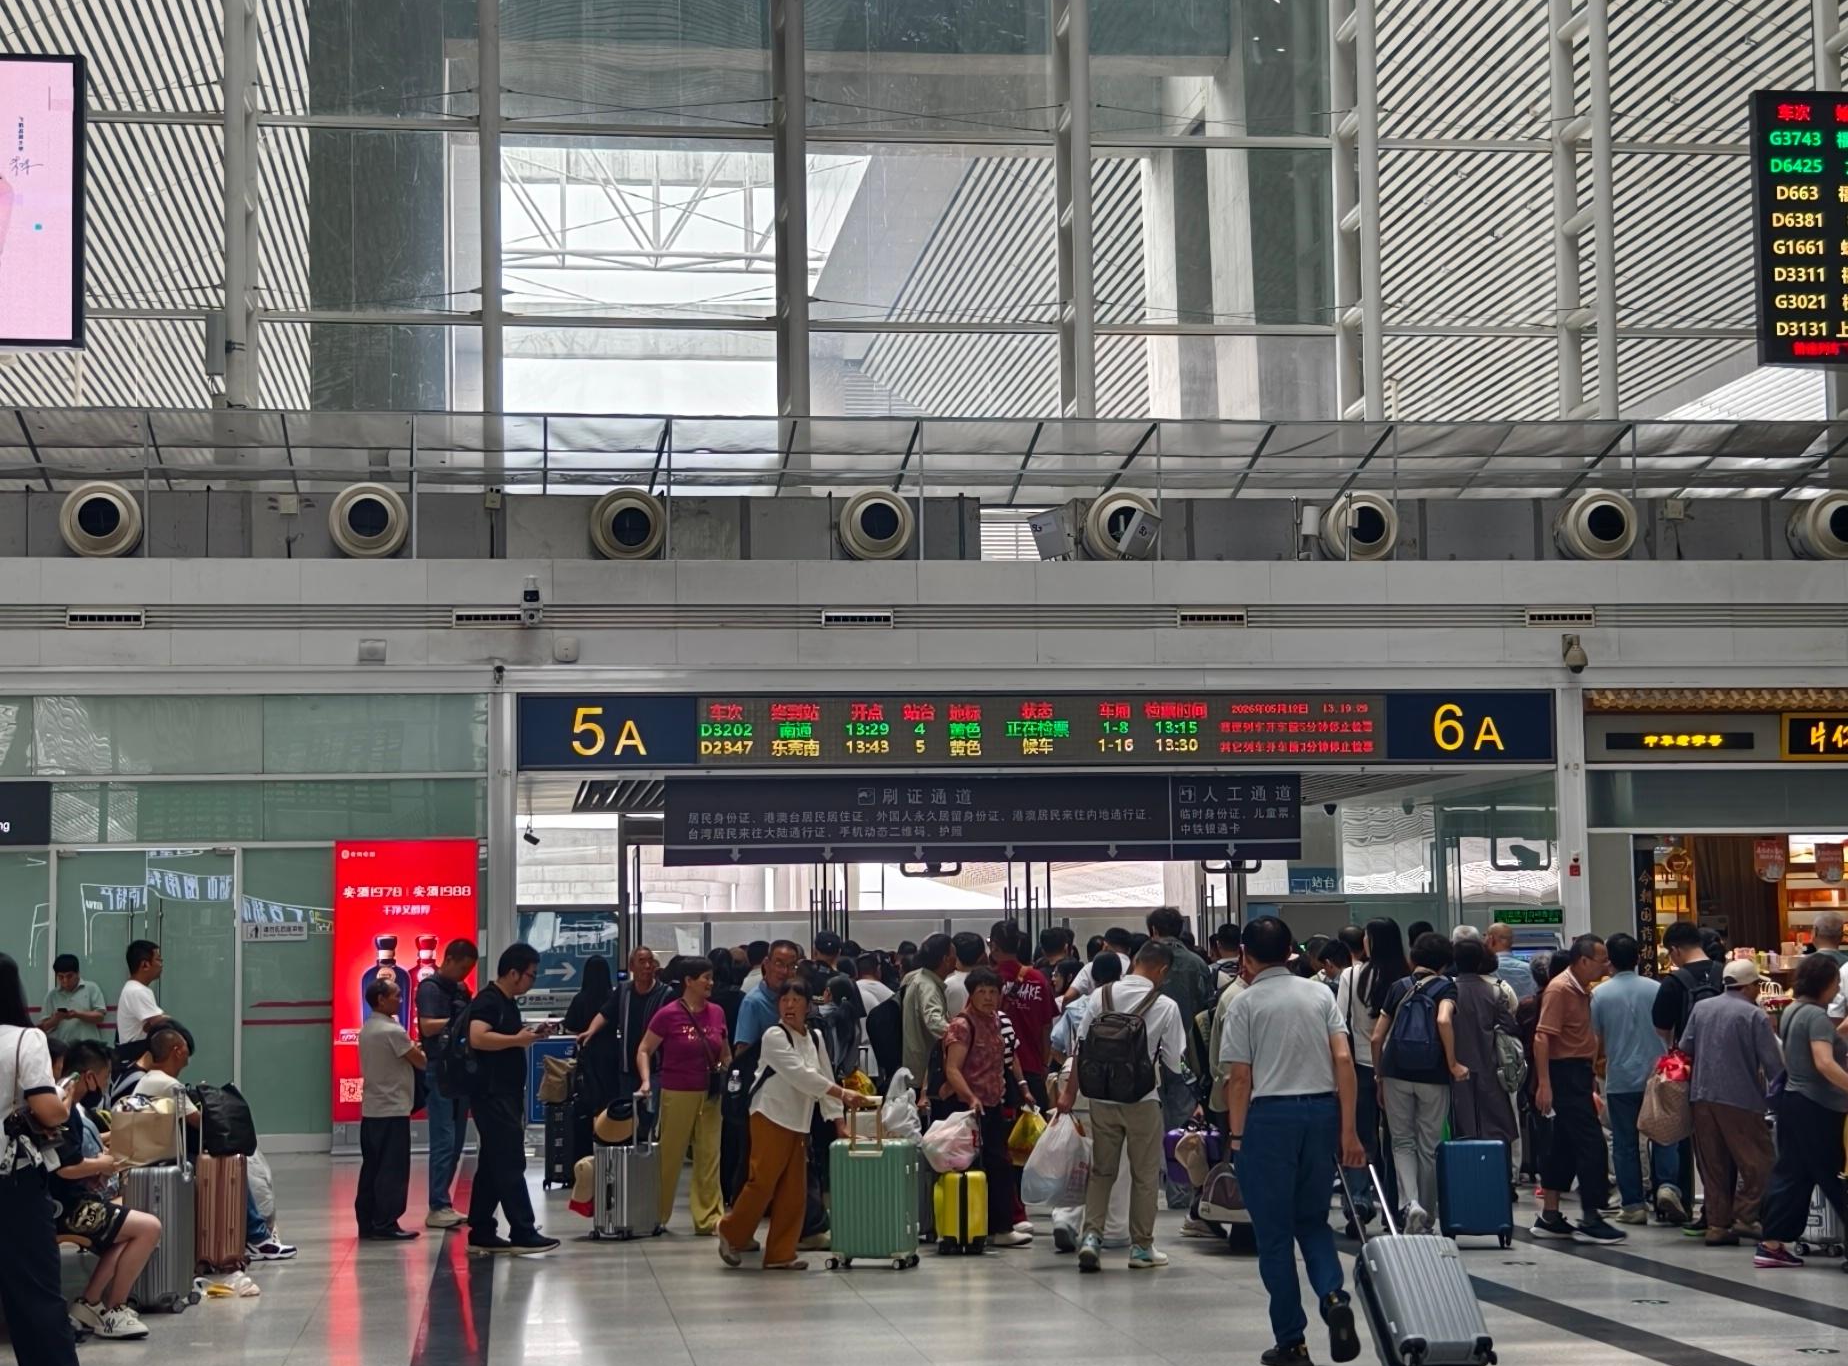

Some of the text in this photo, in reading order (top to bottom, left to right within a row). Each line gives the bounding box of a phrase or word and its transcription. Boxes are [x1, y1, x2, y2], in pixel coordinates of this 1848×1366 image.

[1777, 104, 1811, 121] 车次
[1769, 132, 1822, 147] G3743
[1770, 159, 1823, 174] D6425
[1776, 186, 1819, 201] D663
[1772, 213, 1823, 228] D6381
[1773, 240, 1825, 255] G1661
[1774, 267, 1826, 282] D3311
[1775, 294, 1827, 310] G3021
[1776, 322, 1827, 337] D3131
[709, 704, 743, 721] 车次
[851, 704, 884, 721] 开点
[903, 704, 935, 721] 站台
[571, 707, 648, 757] 5A
[701, 721, 1198, 739] D3202 南通 13:29 4 黄色 正在检票 1-8 13:15
[1433, 703, 1505, 751] 6A
[701, 738, 1198, 756] D2347 东莞南 13:43 5 黄色 候车 1-16 13:30
[882, 787, 973, 806] 刷证通道
[1202, 785, 1292, 803] 人工通道
[1180, 822, 1241, 836] 中铁银通卡
